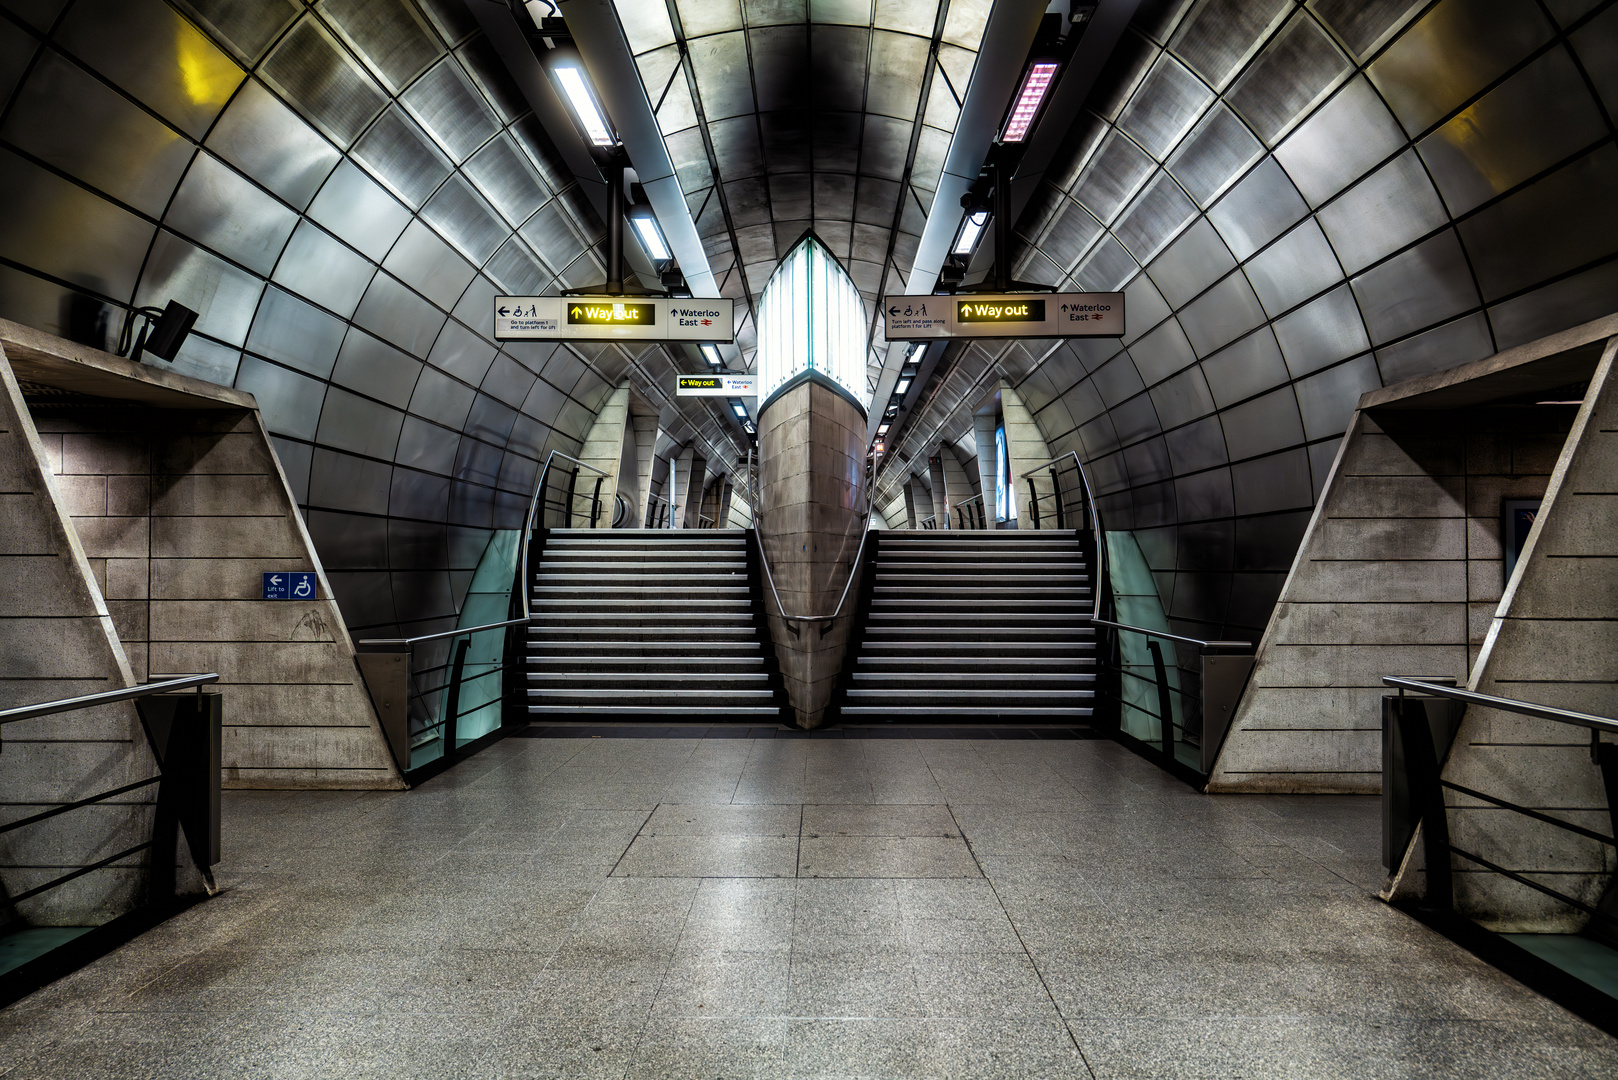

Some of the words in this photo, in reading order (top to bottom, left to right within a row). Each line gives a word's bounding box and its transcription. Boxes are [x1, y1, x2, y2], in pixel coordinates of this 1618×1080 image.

[680, 309, 720, 317] Waterloo
[975, 305, 1002, 318] Way
[1005, 305, 1028, 316] out
[1070, 304, 1111, 312] Waterloo
[585, 307, 613, 321] Way
[614, 308, 638, 319] out
